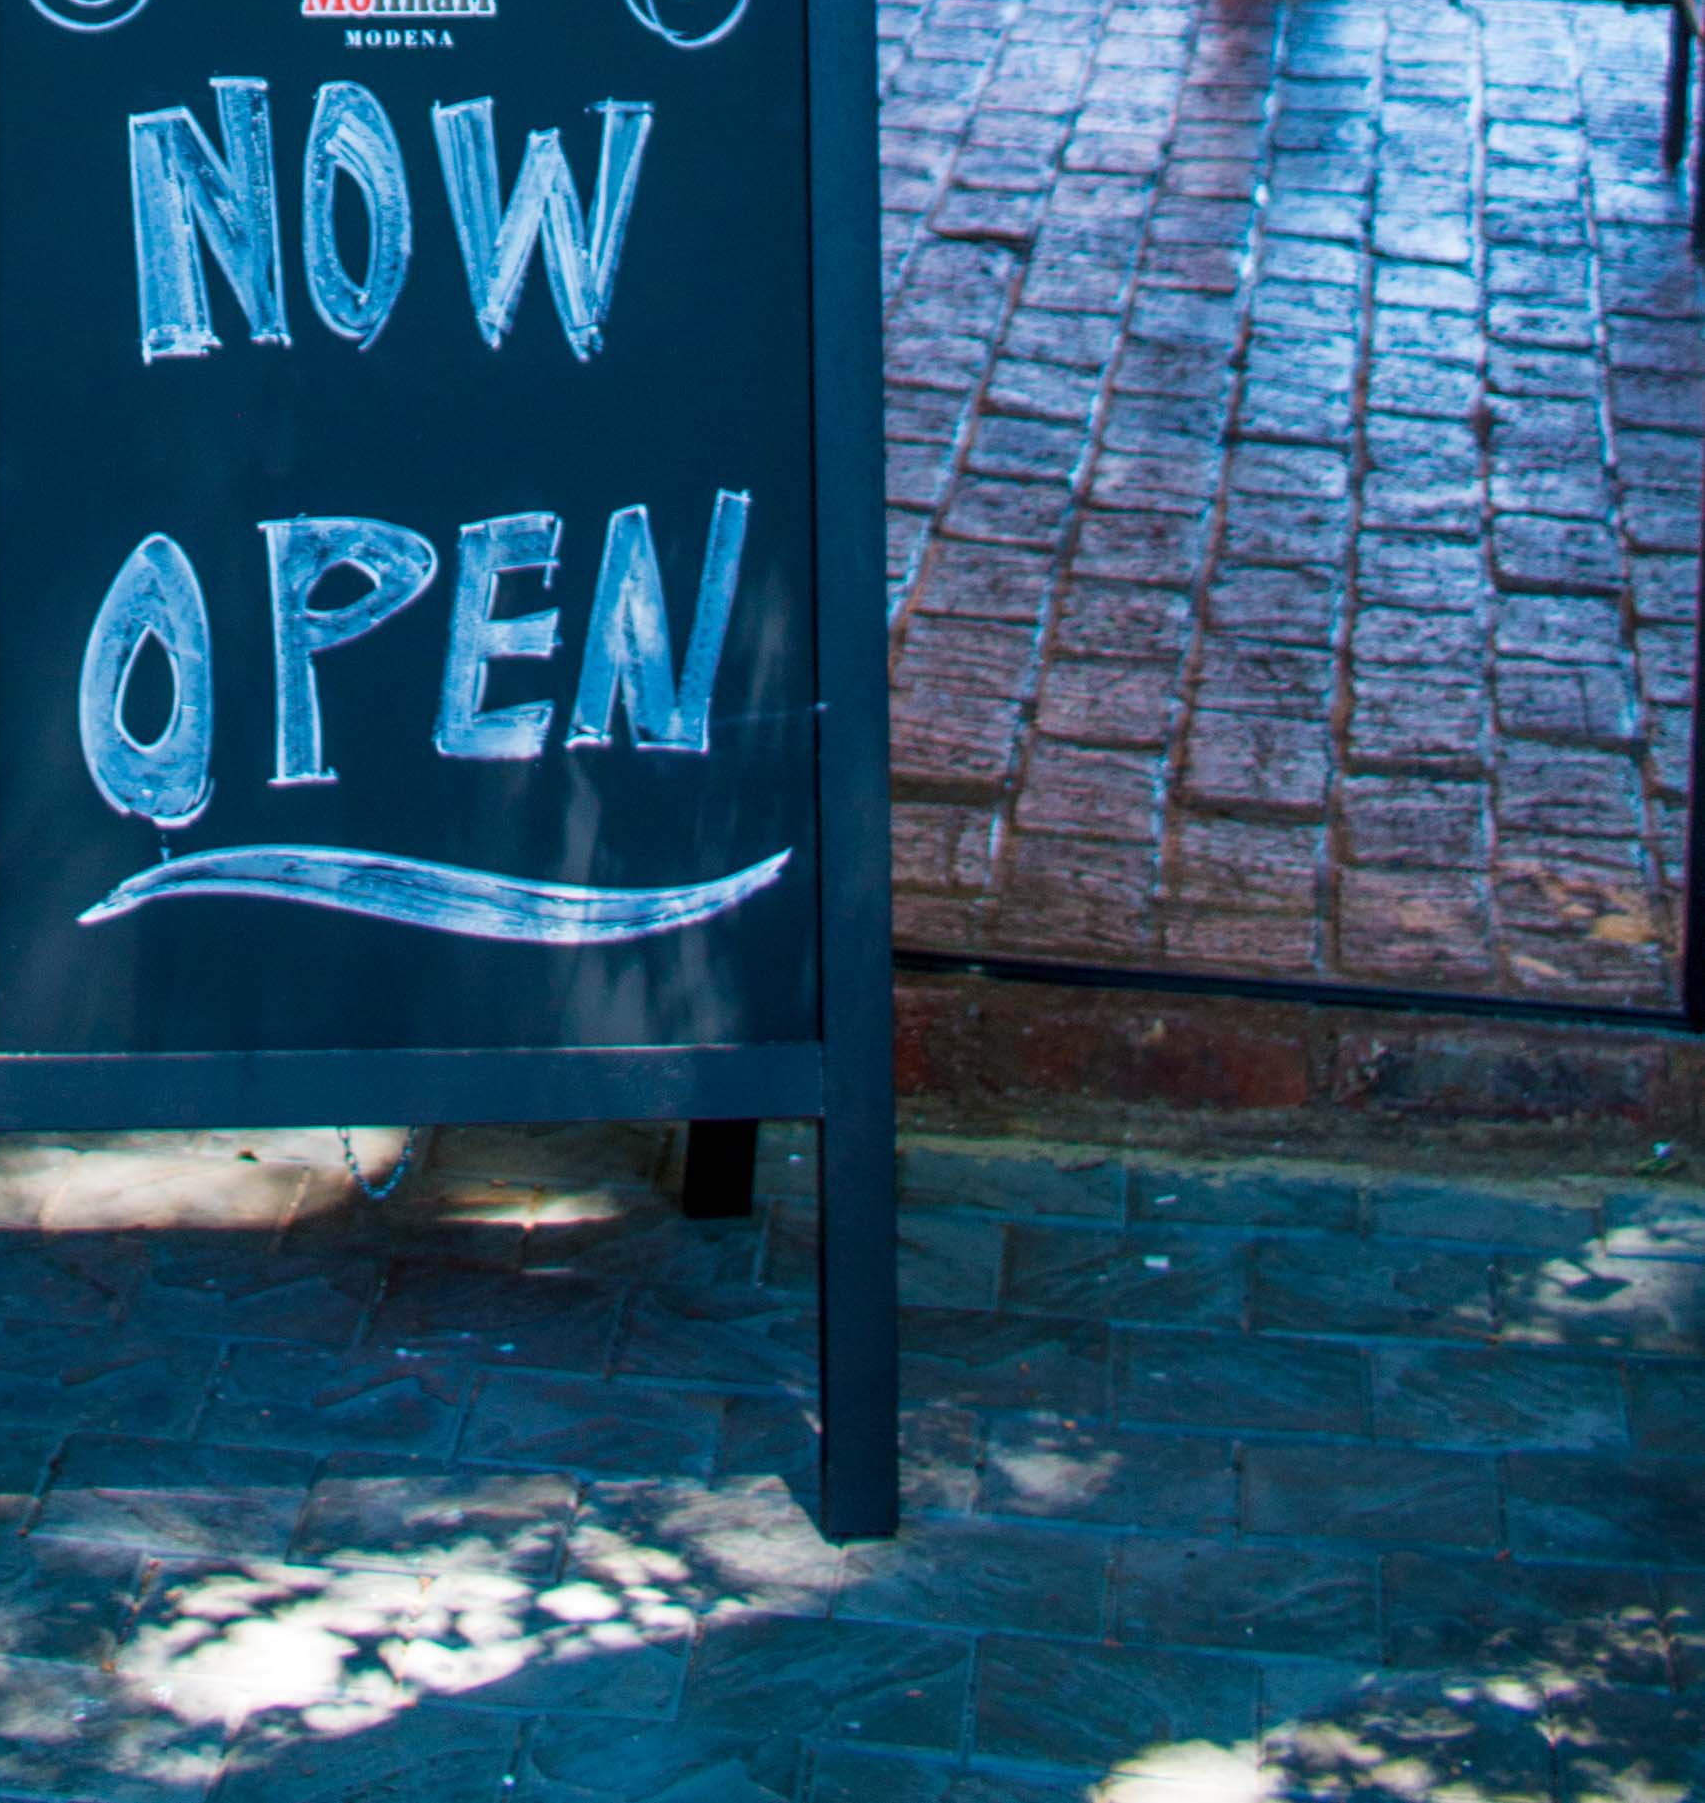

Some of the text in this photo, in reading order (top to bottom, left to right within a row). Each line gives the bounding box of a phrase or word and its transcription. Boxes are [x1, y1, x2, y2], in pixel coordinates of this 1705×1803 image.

[343, 29, 454, 48] MODENA
[128, 76, 654, 364] NOW
[79, 488, 752, 828] OPEN
